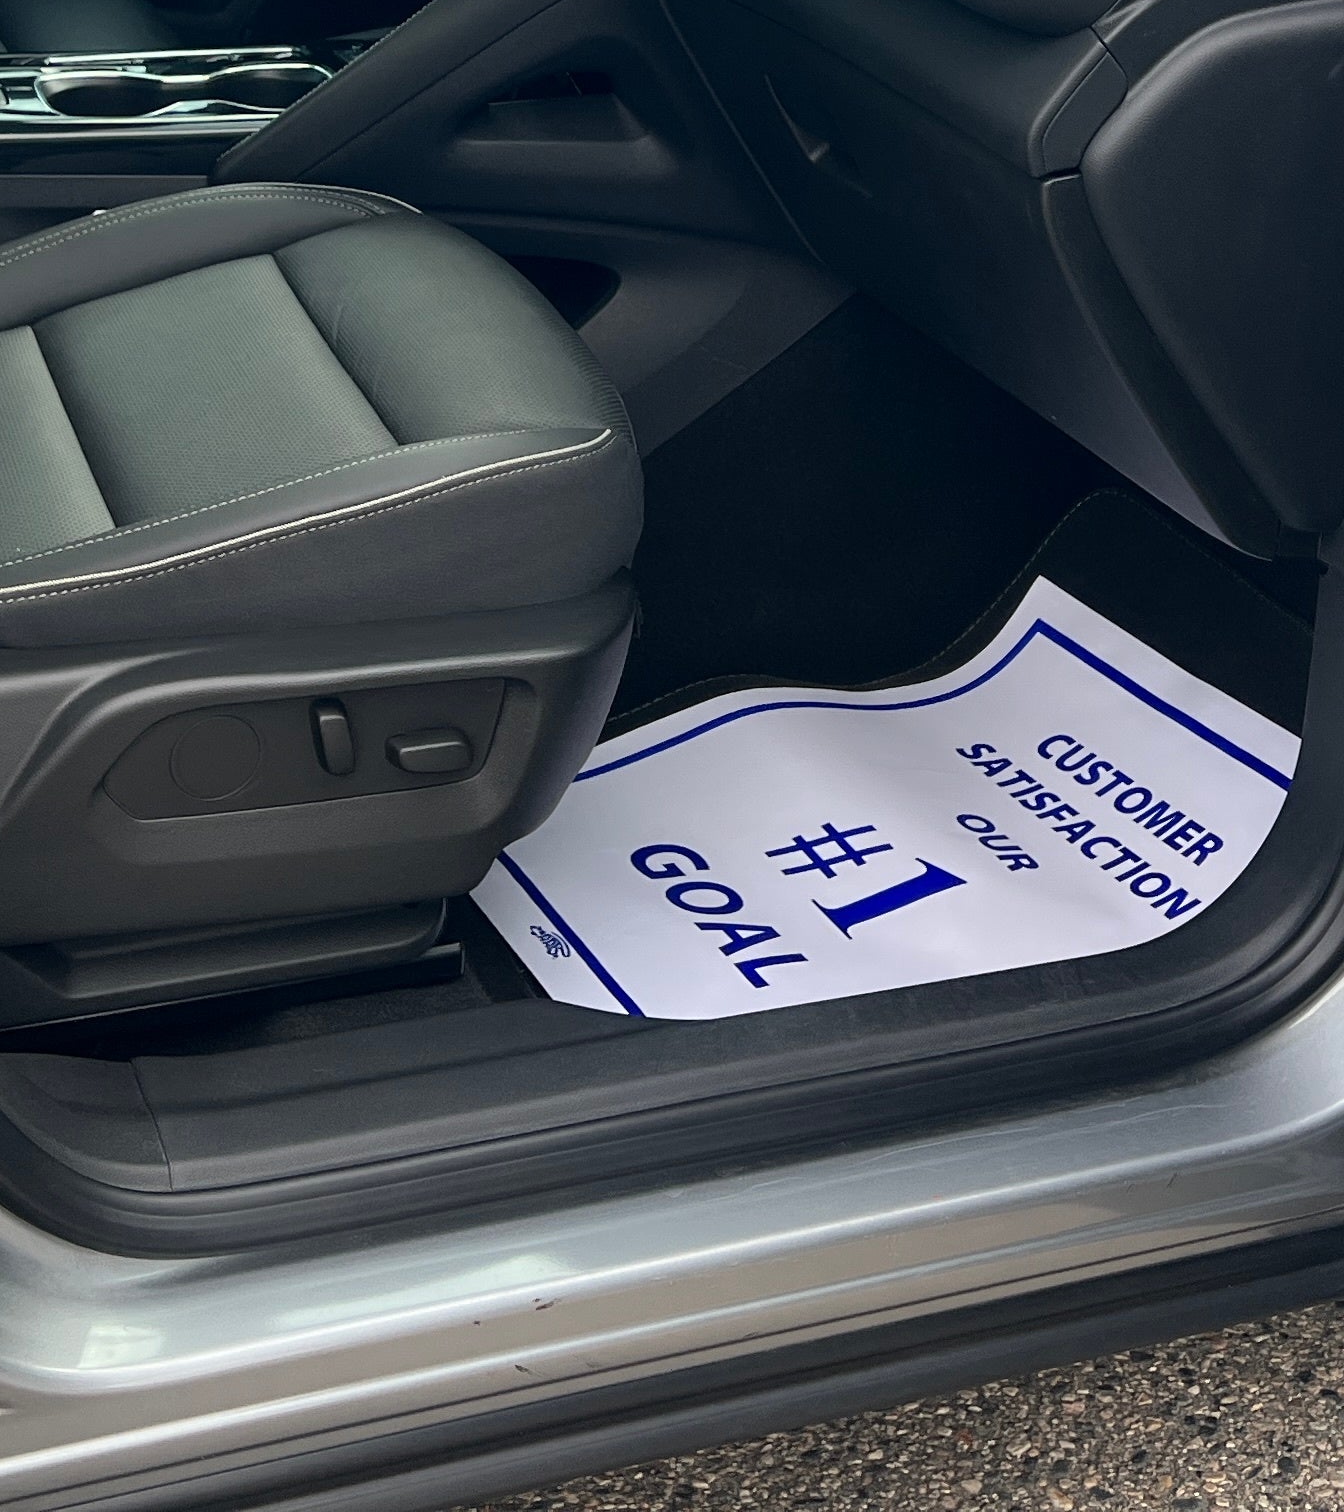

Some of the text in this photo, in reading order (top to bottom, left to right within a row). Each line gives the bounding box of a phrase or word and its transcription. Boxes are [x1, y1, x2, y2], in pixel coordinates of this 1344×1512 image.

[956, 743, 1202, 920] SATISFACTION
[956, 813, 1039, 871] OUR
[1037, 734, 1224, 866] CUSTOMER
[630, 844, 809, 988] GOAL
[764, 822, 968, 940] #1
